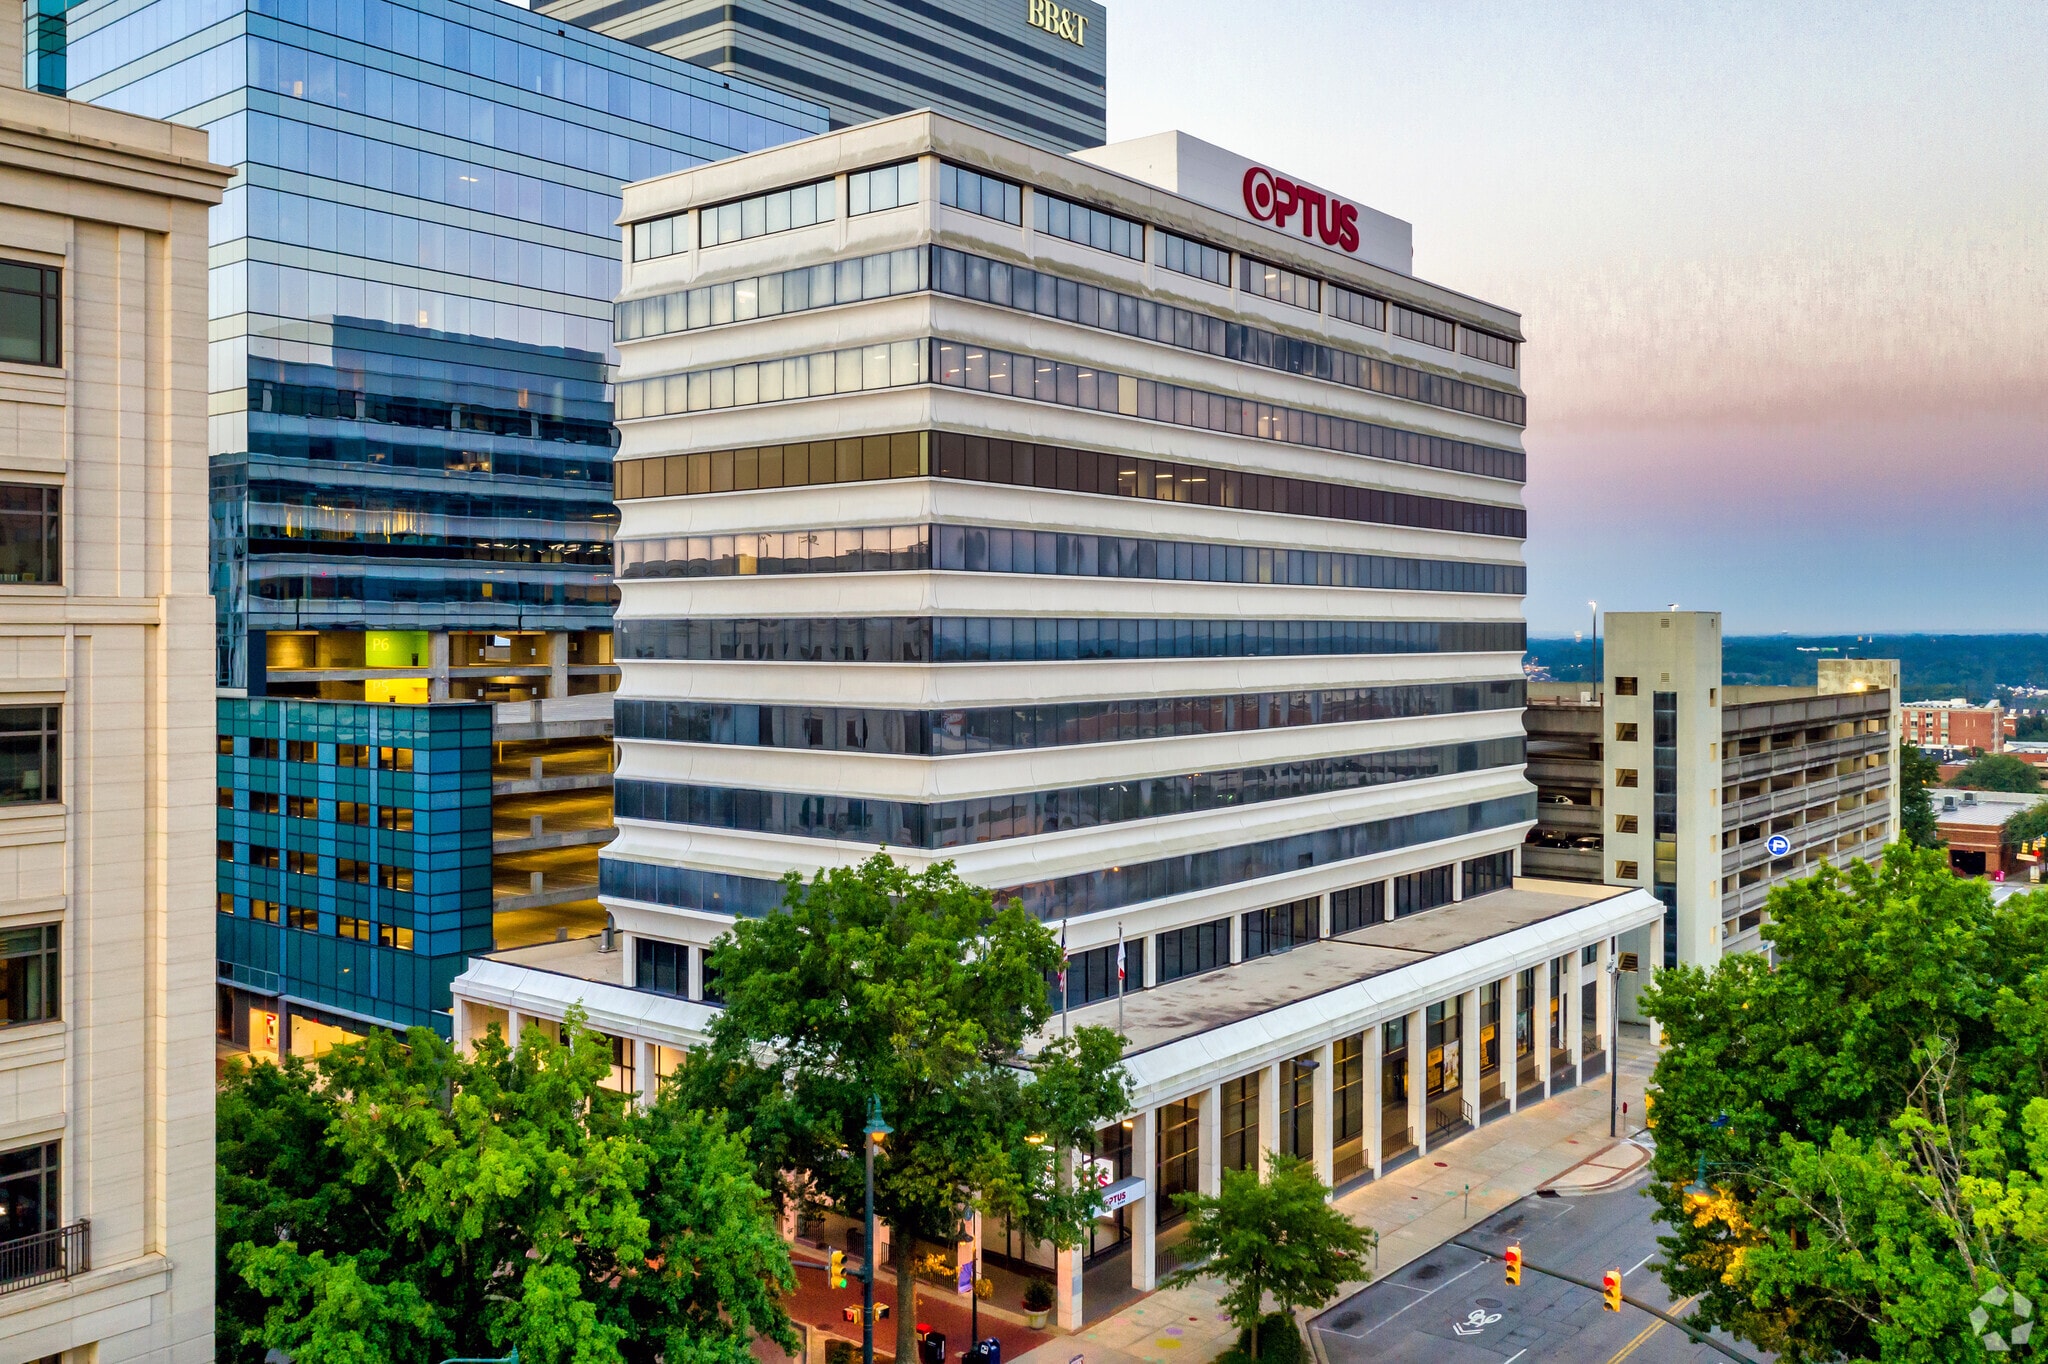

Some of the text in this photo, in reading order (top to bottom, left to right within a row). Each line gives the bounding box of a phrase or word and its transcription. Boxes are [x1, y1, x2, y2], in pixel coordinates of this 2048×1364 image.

[1026, 0, 1089, 47] BB&T
[1243, 166, 1360, 253] OPTUS
[373, 638, 389, 651] P6
